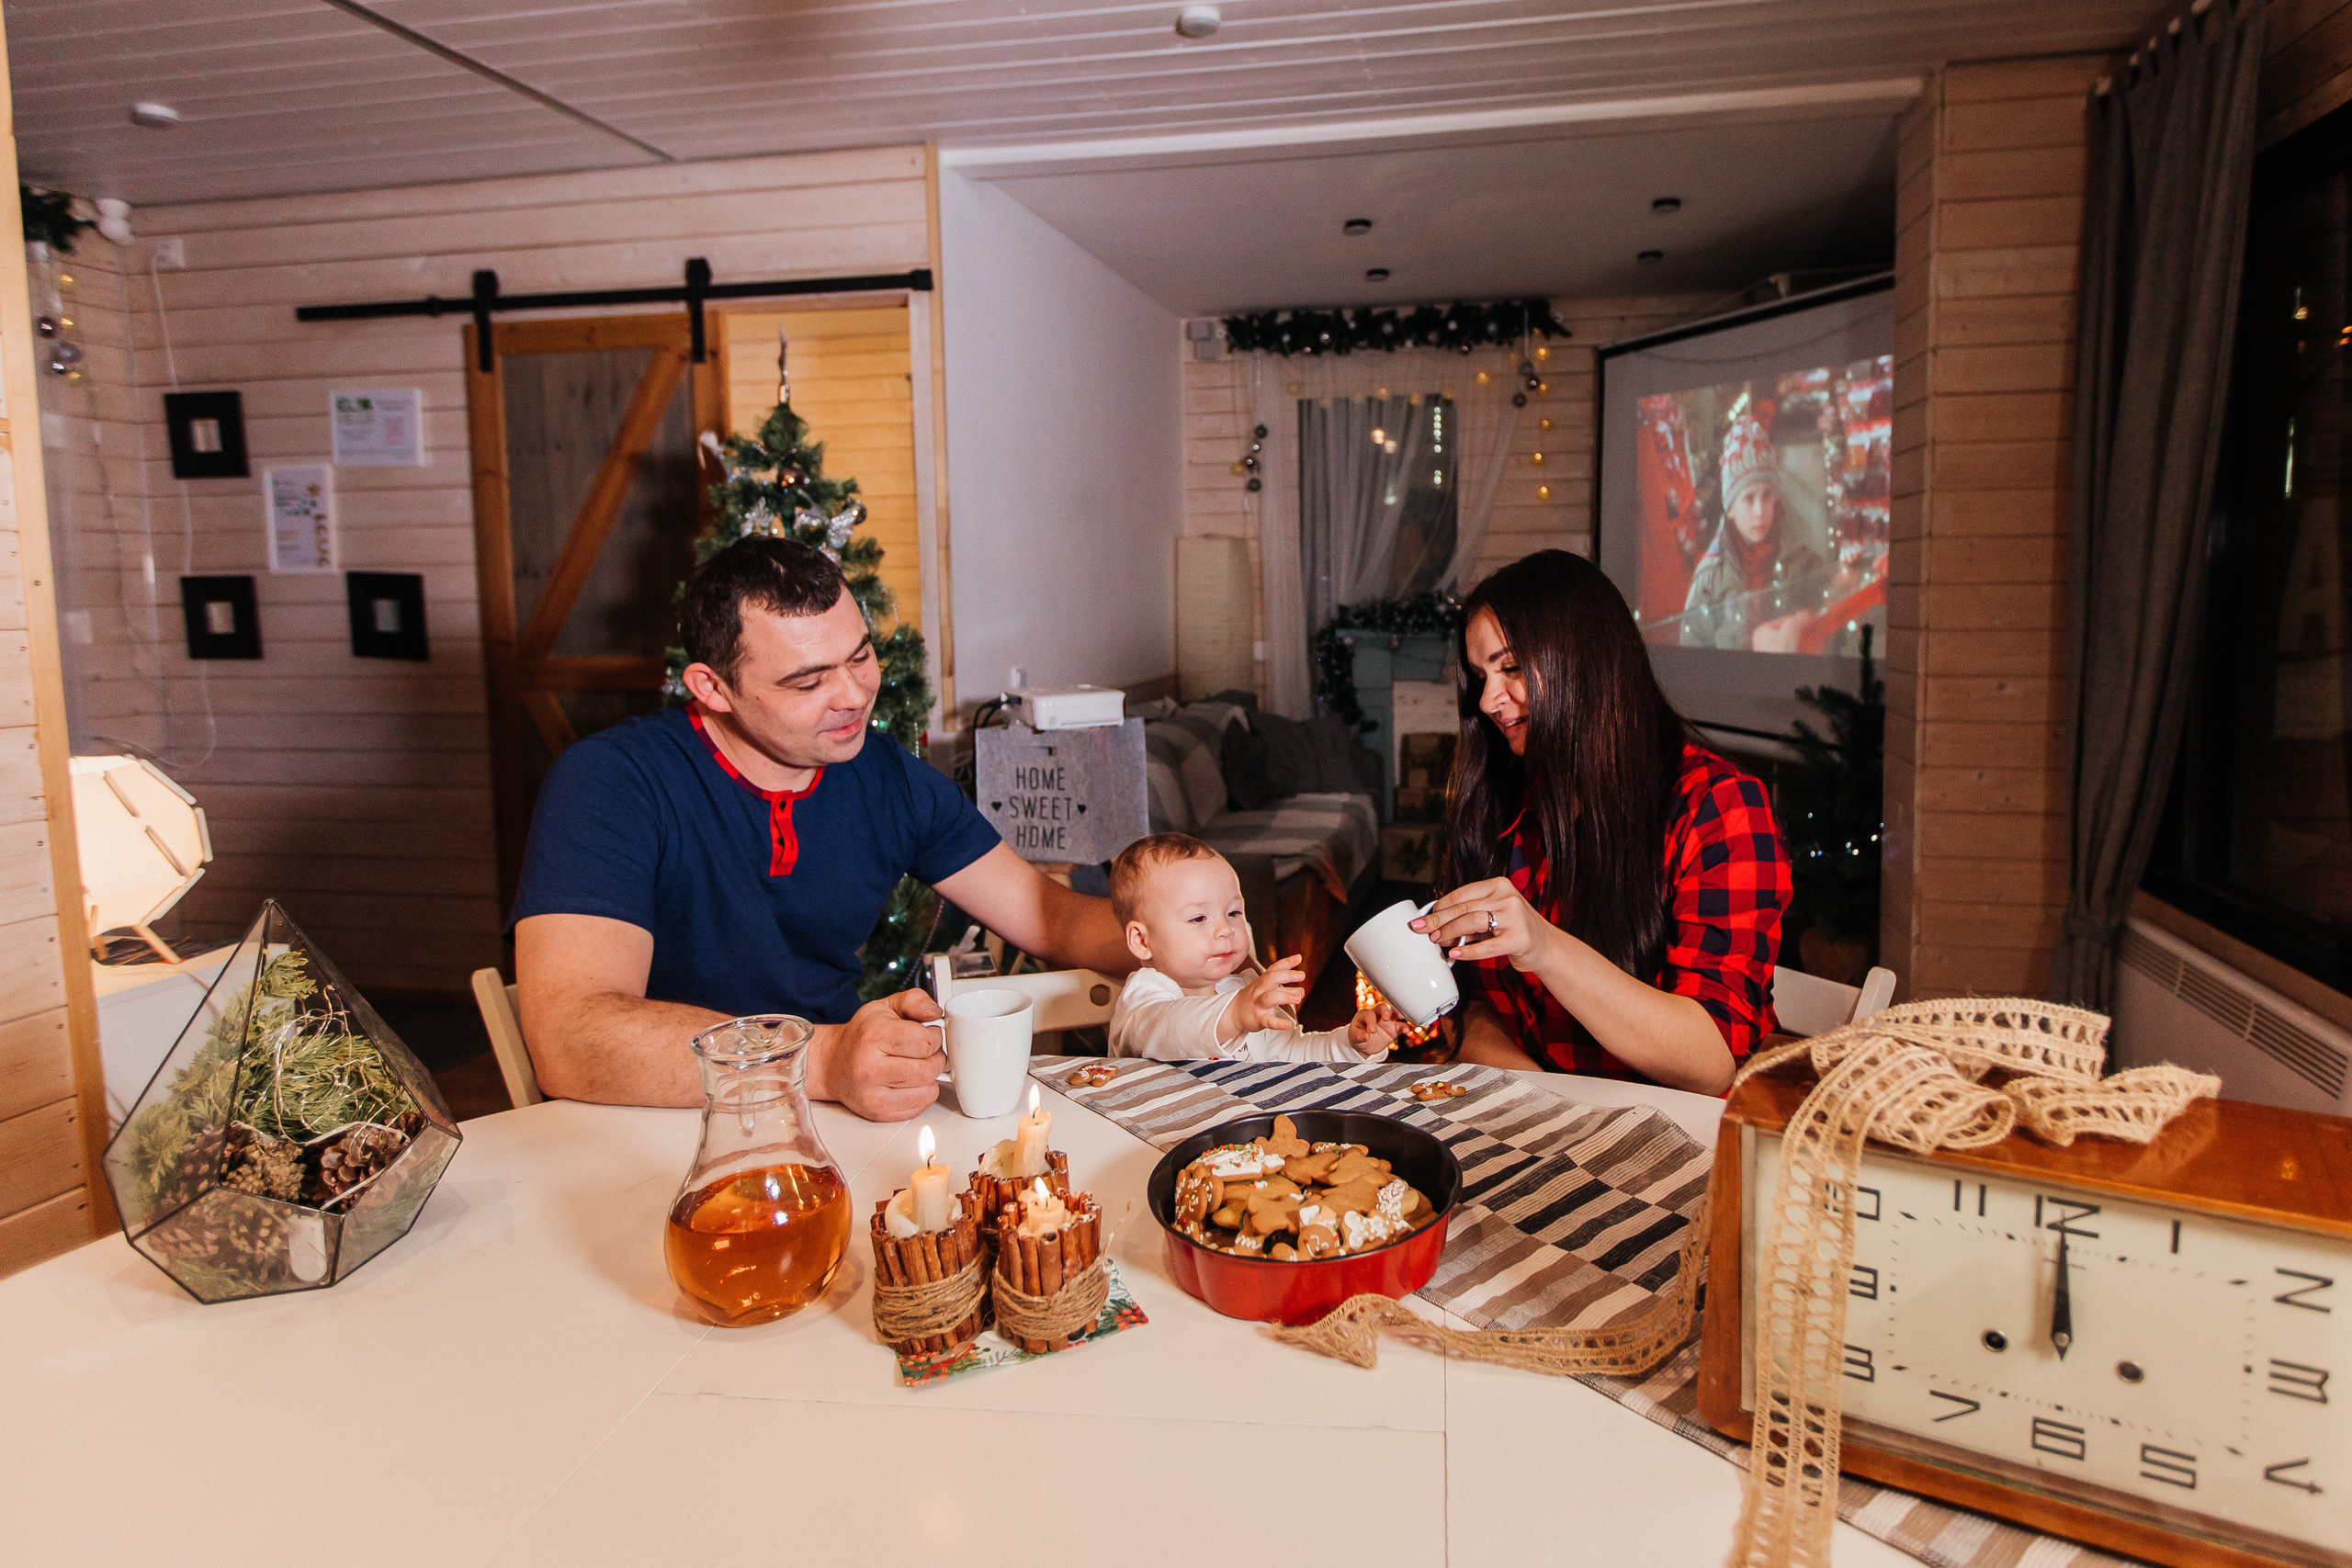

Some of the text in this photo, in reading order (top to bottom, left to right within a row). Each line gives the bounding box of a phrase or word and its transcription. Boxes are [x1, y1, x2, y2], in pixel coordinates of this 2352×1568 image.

[1016, 766, 1066, 791] HOME
[1010, 795, 1072, 820] SWEET
[1016, 825, 1067, 850] HOME
[1953, 1179, 1986, 1217] 11
[2035, 1194, 2100, 1239] 12
[2170, 1219, 2181, 1255] 1
[2273, 1267, 2334, 1314] 2
[2267, 1358, 2329, 1404] 3
[1928, 1388, 1981, 1423] 7
[2031, 1416, 2086, 1461] 6
[2140, 1443, 2197, 1490] 5
[2263, 1457, 2324, 1495] 4
